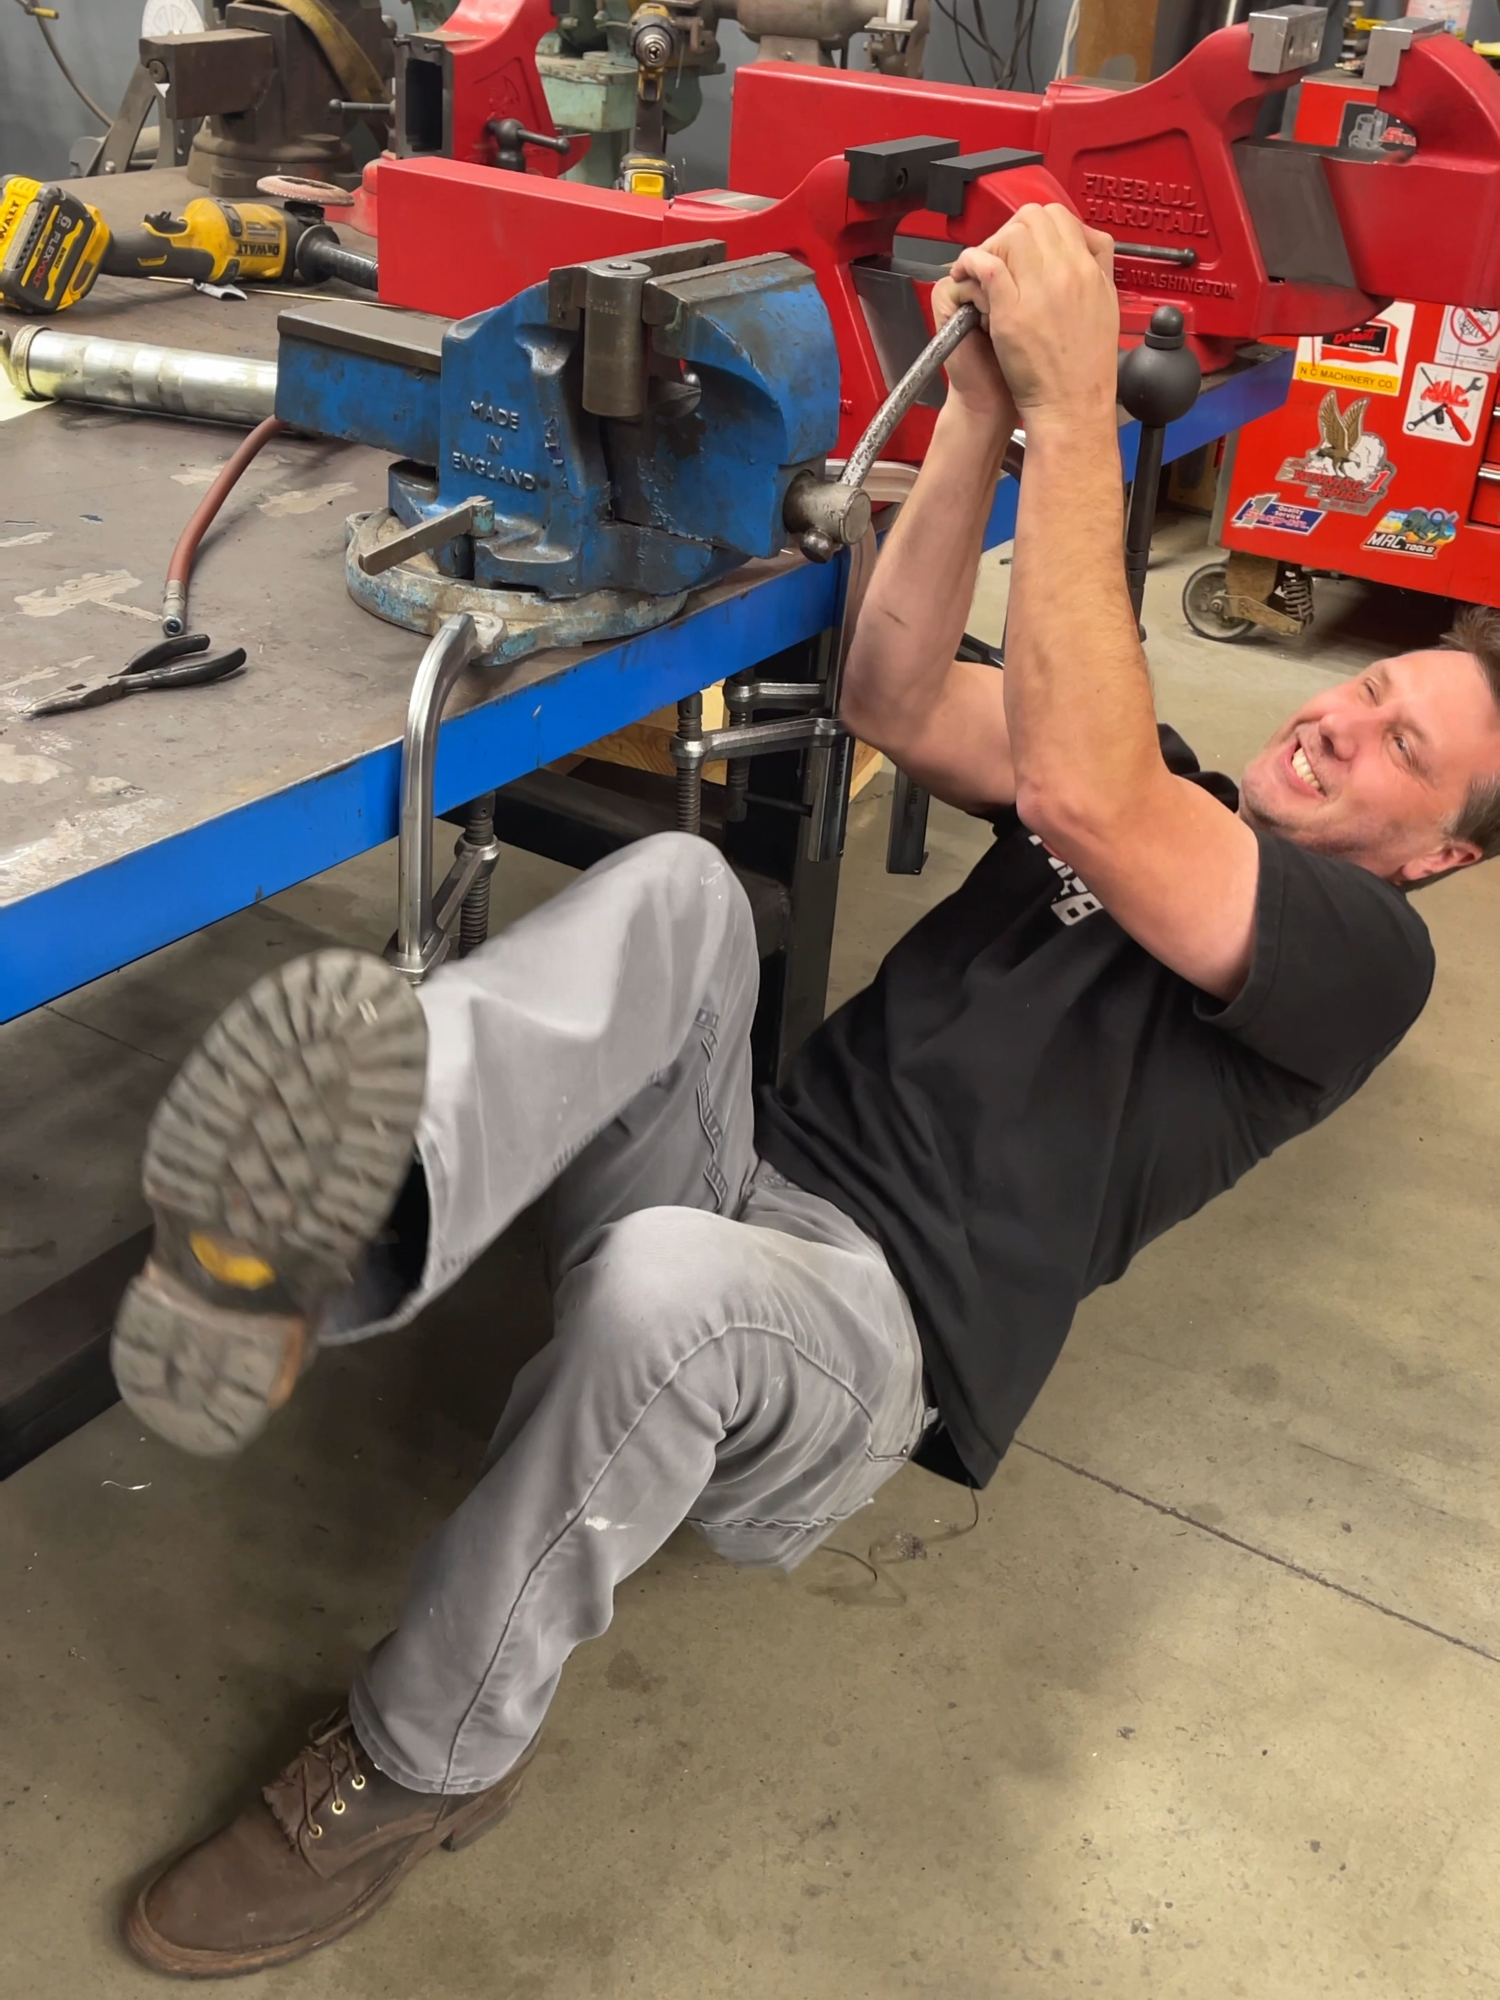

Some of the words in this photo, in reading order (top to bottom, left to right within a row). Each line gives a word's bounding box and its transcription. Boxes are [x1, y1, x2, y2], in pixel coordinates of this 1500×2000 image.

[1081, 172, 1197, 209] FIREBALL
[0, 200, 20, 239] WALT
[60, 215, 72, 229] 6
[1085, 198, 1210, 236] HARDTAIL
[33, 231, 61, 288] FLEXVOLT
[1130, 269, 1238, 299] WASHINGTON
[1300, 366, 1307, 375] N
[1310, 368, 1318, 377] C
[1320, 370, 1376, 387] MACHINERY
[1378, 379, 1394, 390] CO.
[470, 400, 519, 431] MADE
[485, 433, 503, 455] IN
[452, 451, 537, 491] ENGLAND
[1366, 532, 1407, 549] MAC
[1405, 544, 1434, 554] TOOLS
